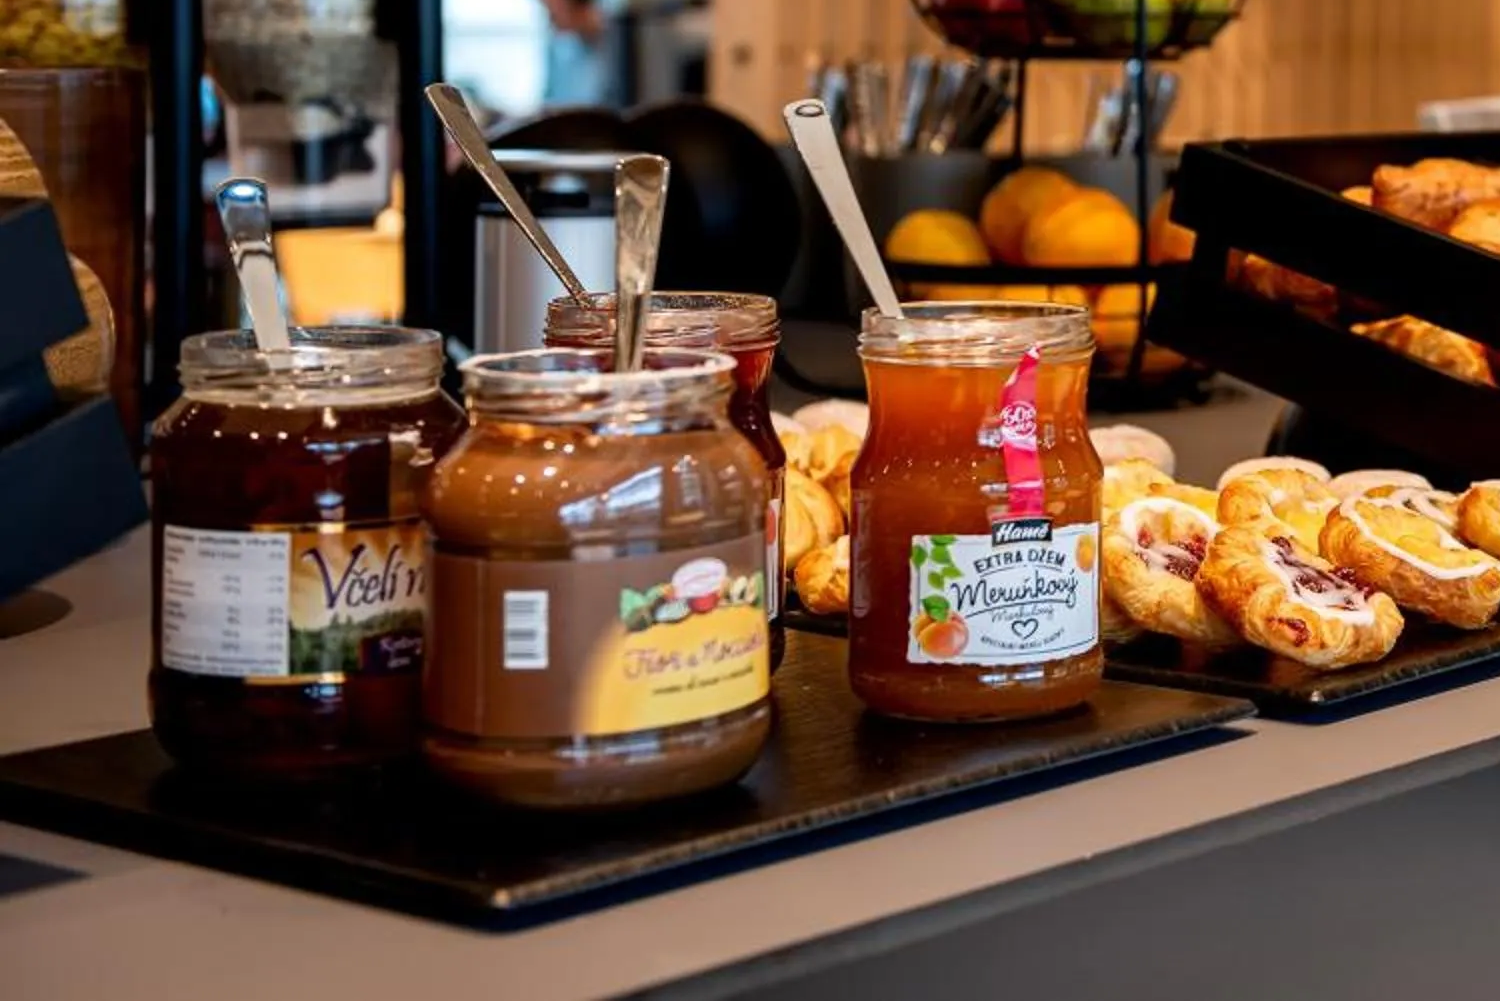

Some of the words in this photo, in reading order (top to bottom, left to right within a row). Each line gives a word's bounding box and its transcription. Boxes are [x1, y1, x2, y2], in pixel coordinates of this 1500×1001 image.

[995, 523, 1049, 542] Hamé
[301, 543, 402, 609] Včelí
[973, 550, 1023, 573] EXTRA
[1028, 548, 1066, 567] DŽEM
[951, 569, 1078, 610] Meruňkový
